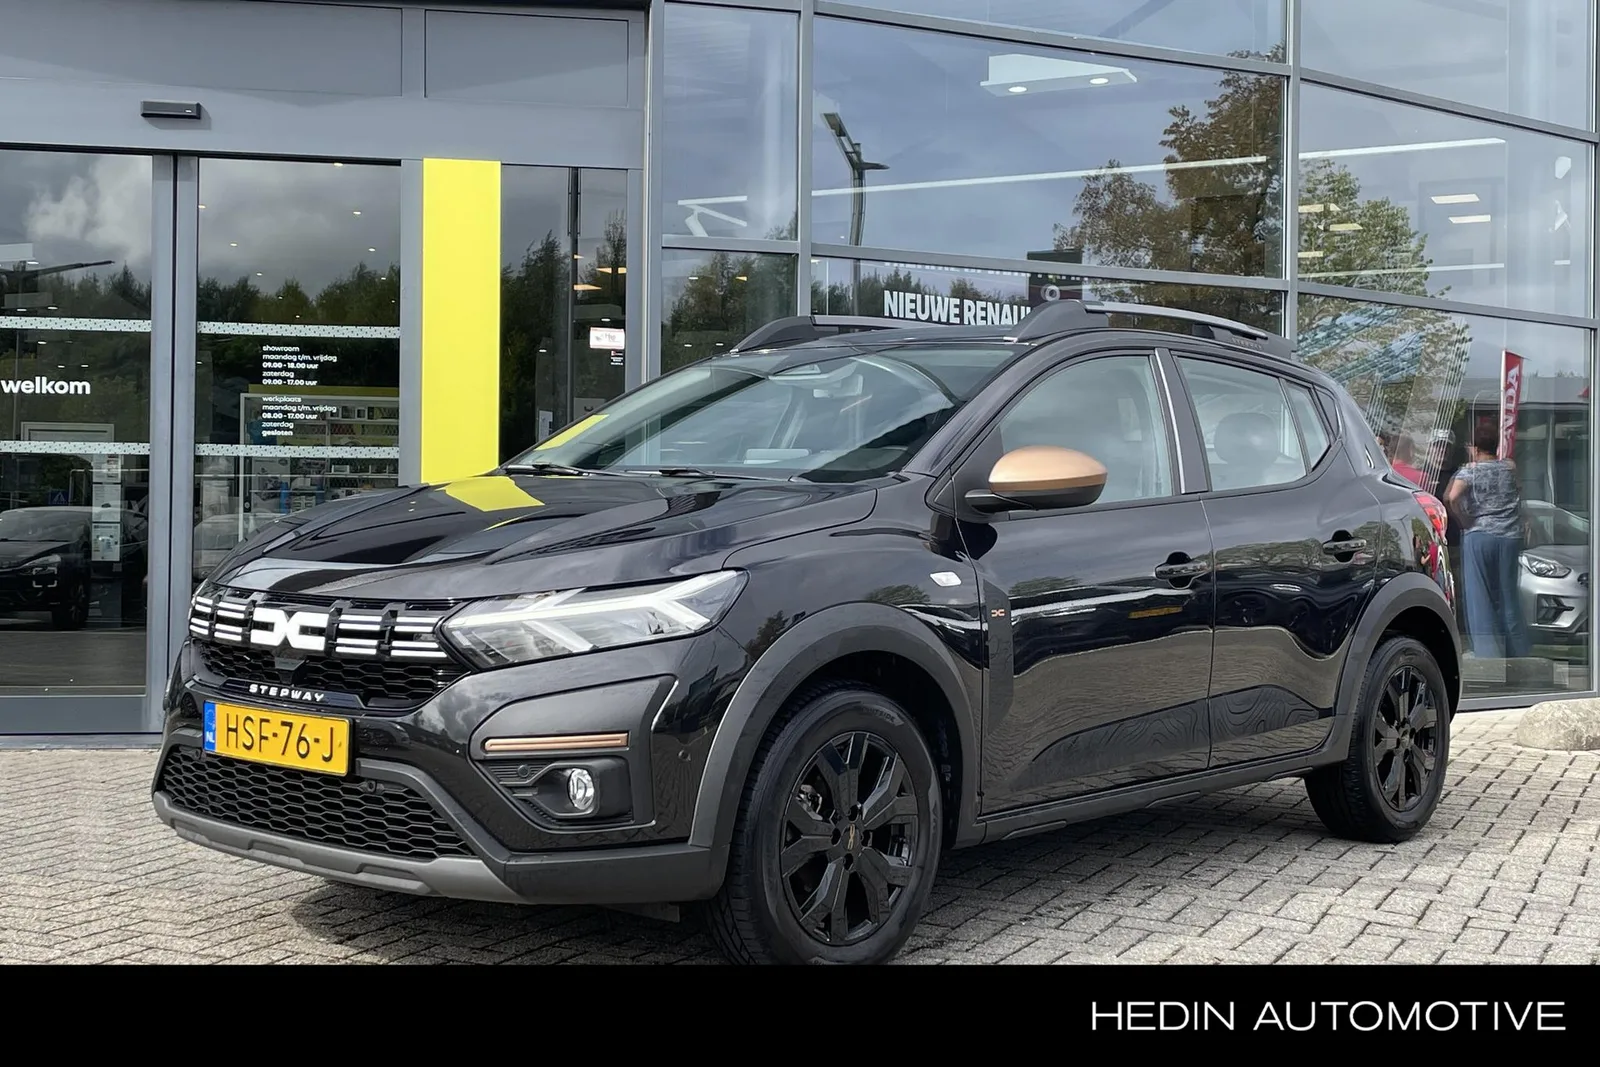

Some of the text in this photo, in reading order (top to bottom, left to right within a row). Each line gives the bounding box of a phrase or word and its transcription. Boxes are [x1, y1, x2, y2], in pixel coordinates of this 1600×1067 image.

[884, 290, 1031, 326] NIEUWE RENAU
[262, 354, 297, 362] maandag
[313, 354, 337, 362] vrijdag
[0, 376, 91, 395] welkom
[312, 405, 337, 413] vrijdag
[261, 421, 294, 429] zaterdag
[261, 429, 294, 437] gesloten
[249, 683, 324, 702] STEPWAY
[205, 731, 215, 743] NL
[226, 713, 334, 763] HSF-76-J
